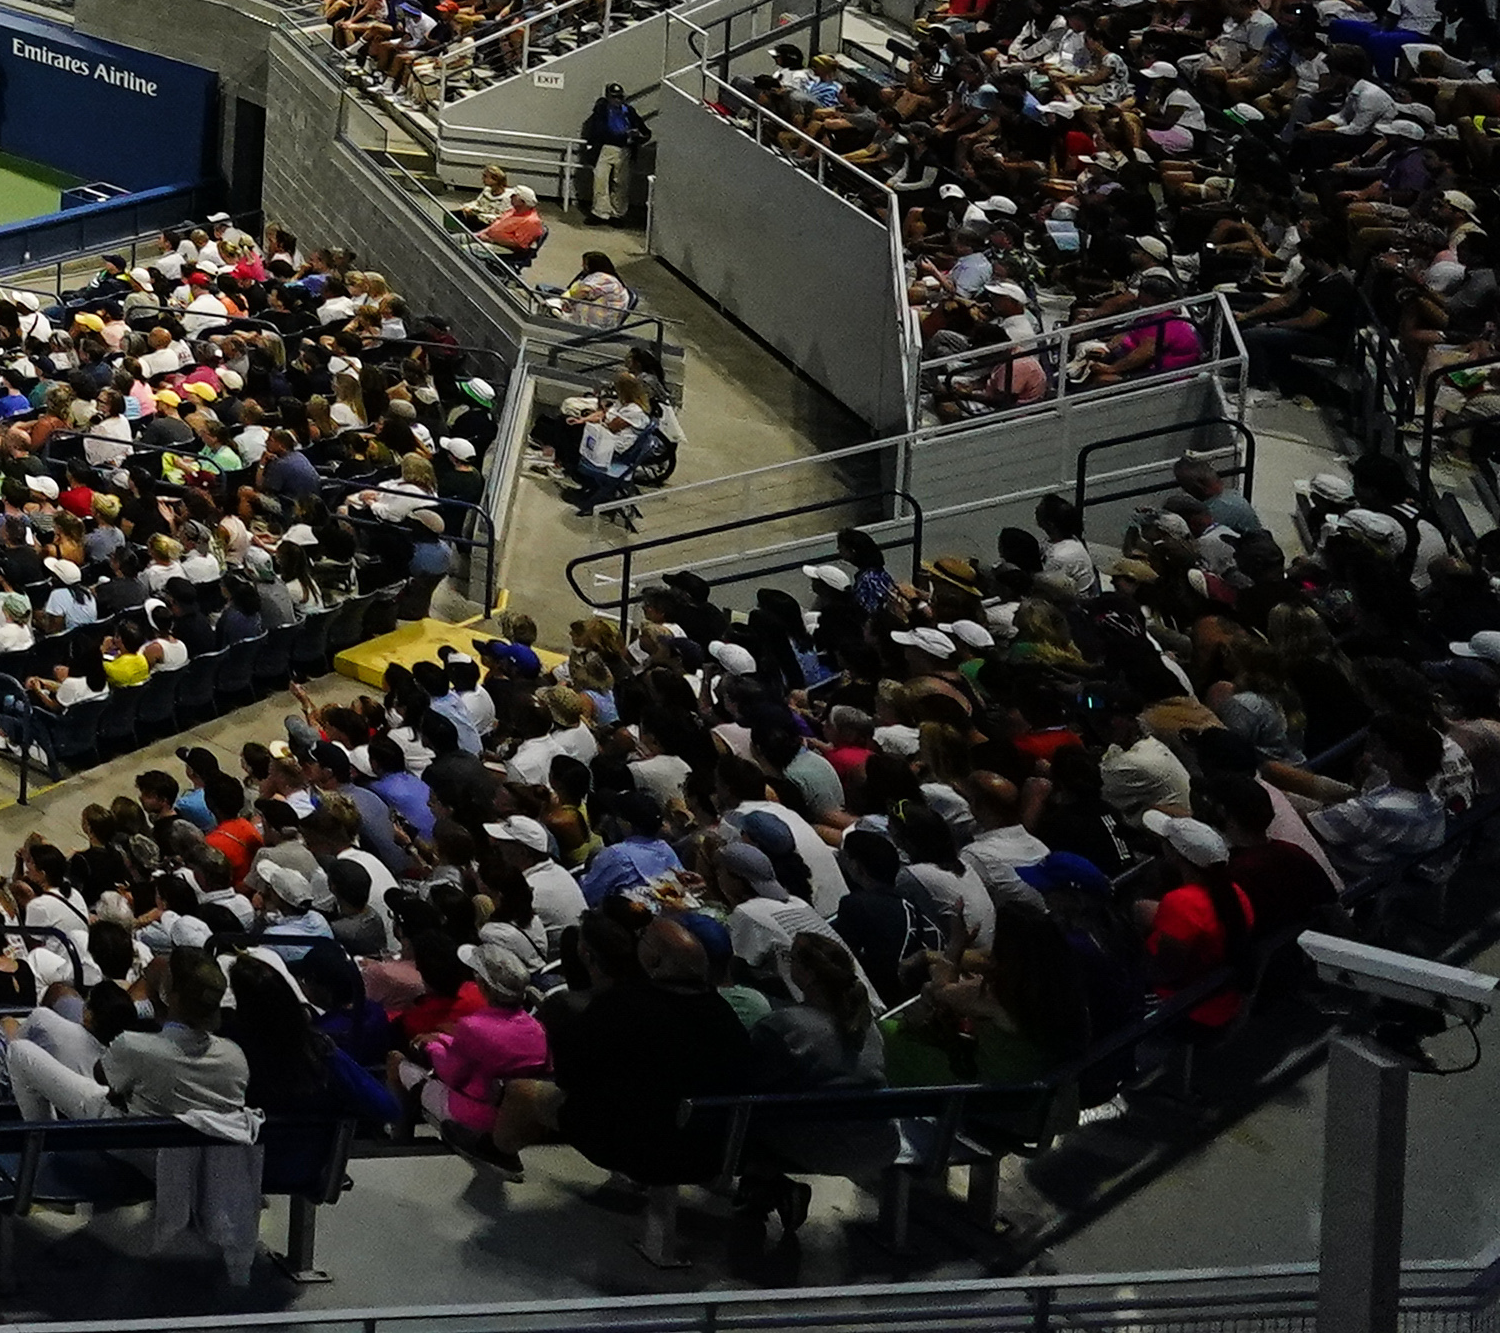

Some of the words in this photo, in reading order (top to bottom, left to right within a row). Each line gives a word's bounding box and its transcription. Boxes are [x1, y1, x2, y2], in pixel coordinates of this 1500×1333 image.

[12, 37, 90, 77] Emirates
[94, 62, 158, 97] Airline
[537, 76, 561, 85] EXIT
